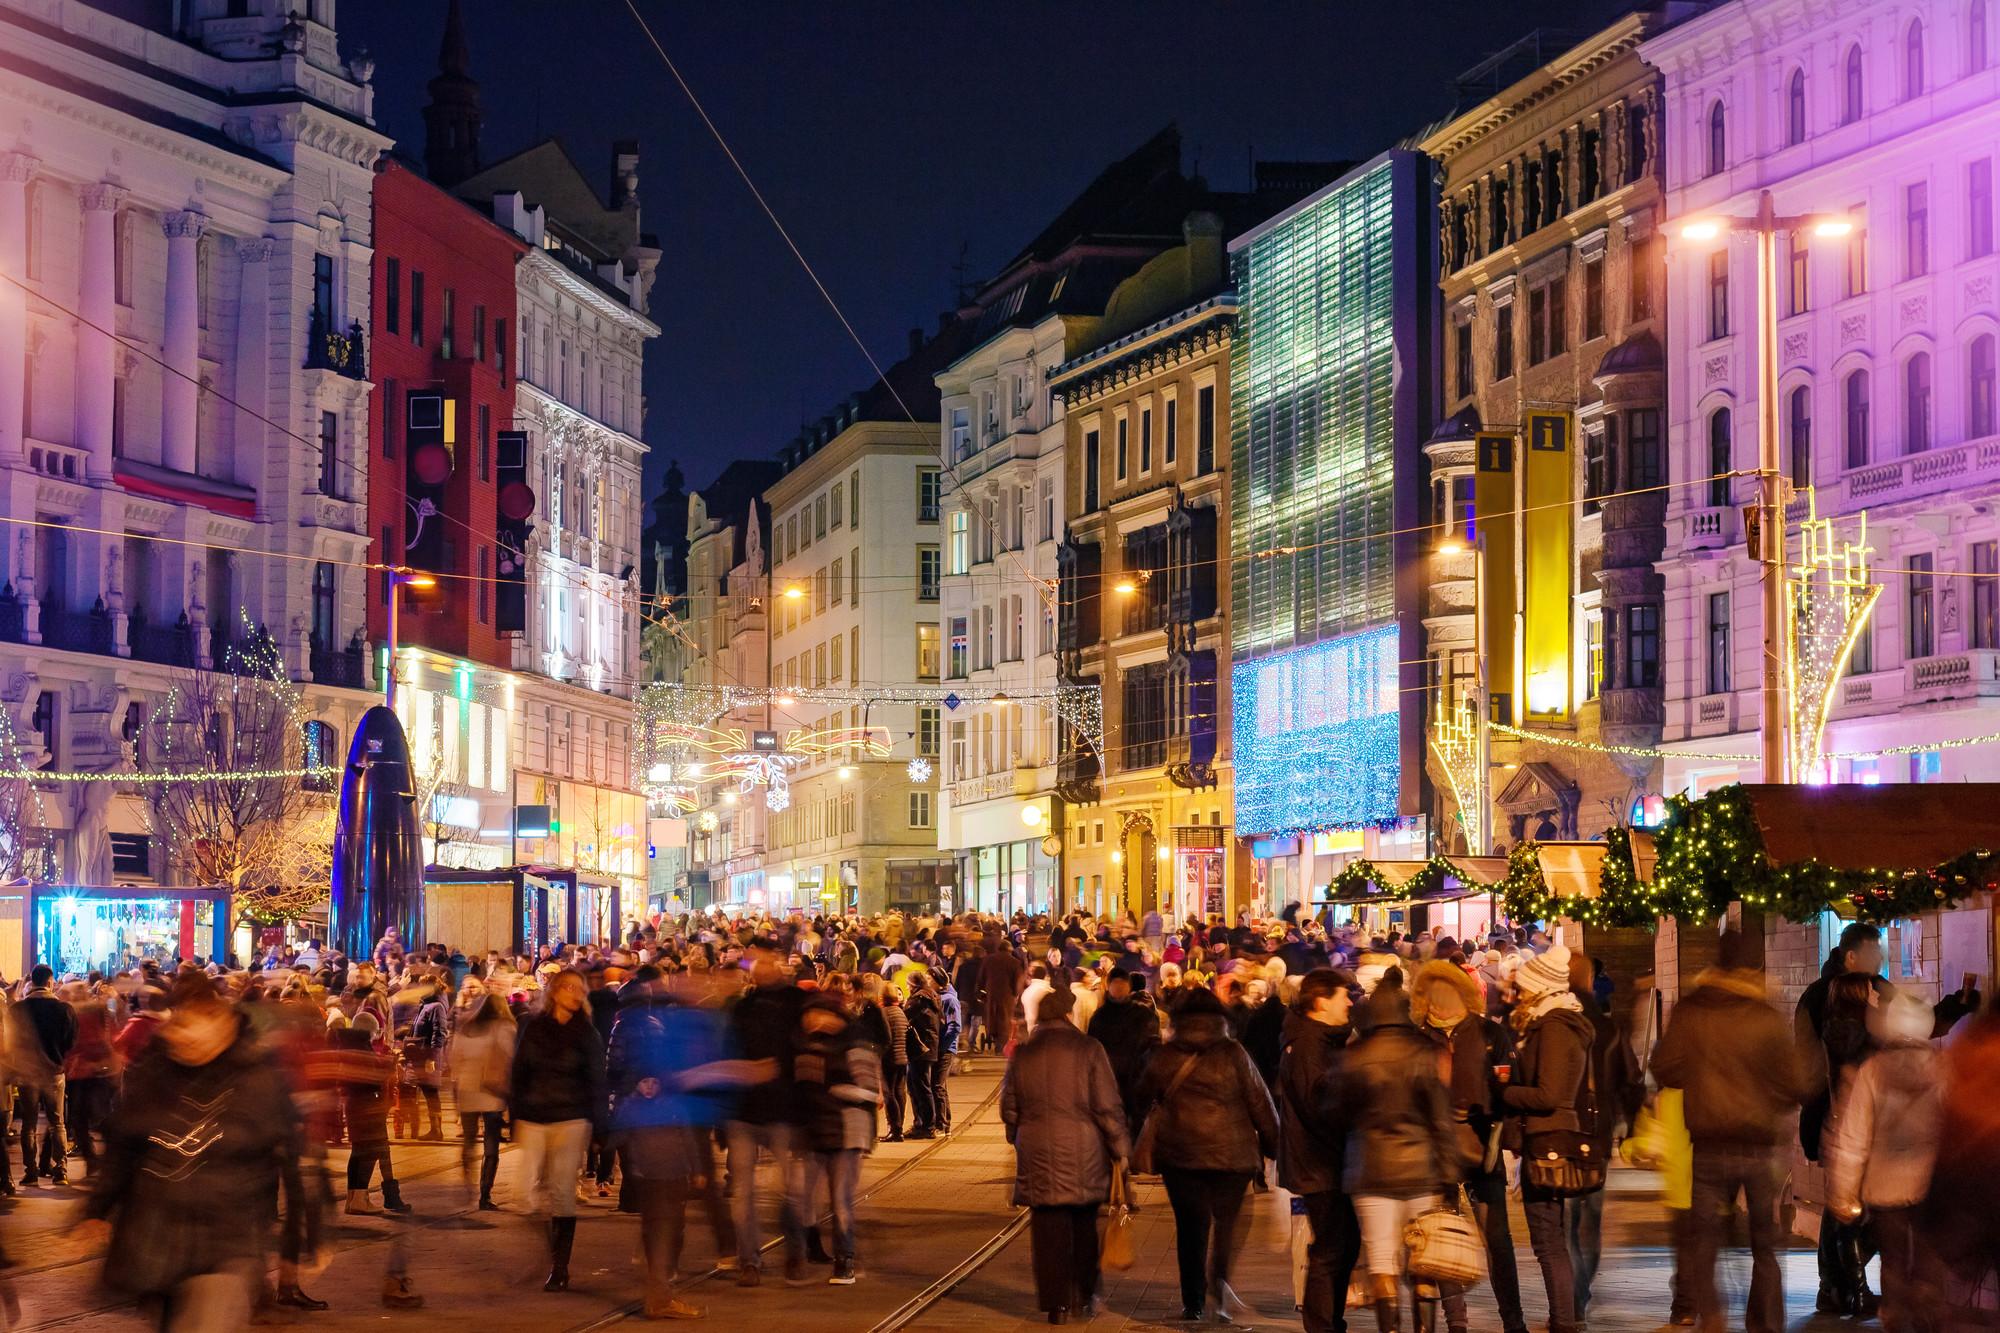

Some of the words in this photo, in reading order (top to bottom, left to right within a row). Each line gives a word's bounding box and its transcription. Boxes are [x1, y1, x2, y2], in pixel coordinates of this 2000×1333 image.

[1543, 421, 1555, 448] i
[1490, 442, 1500, 469] i
[1490, 696, 1499, 722] i
